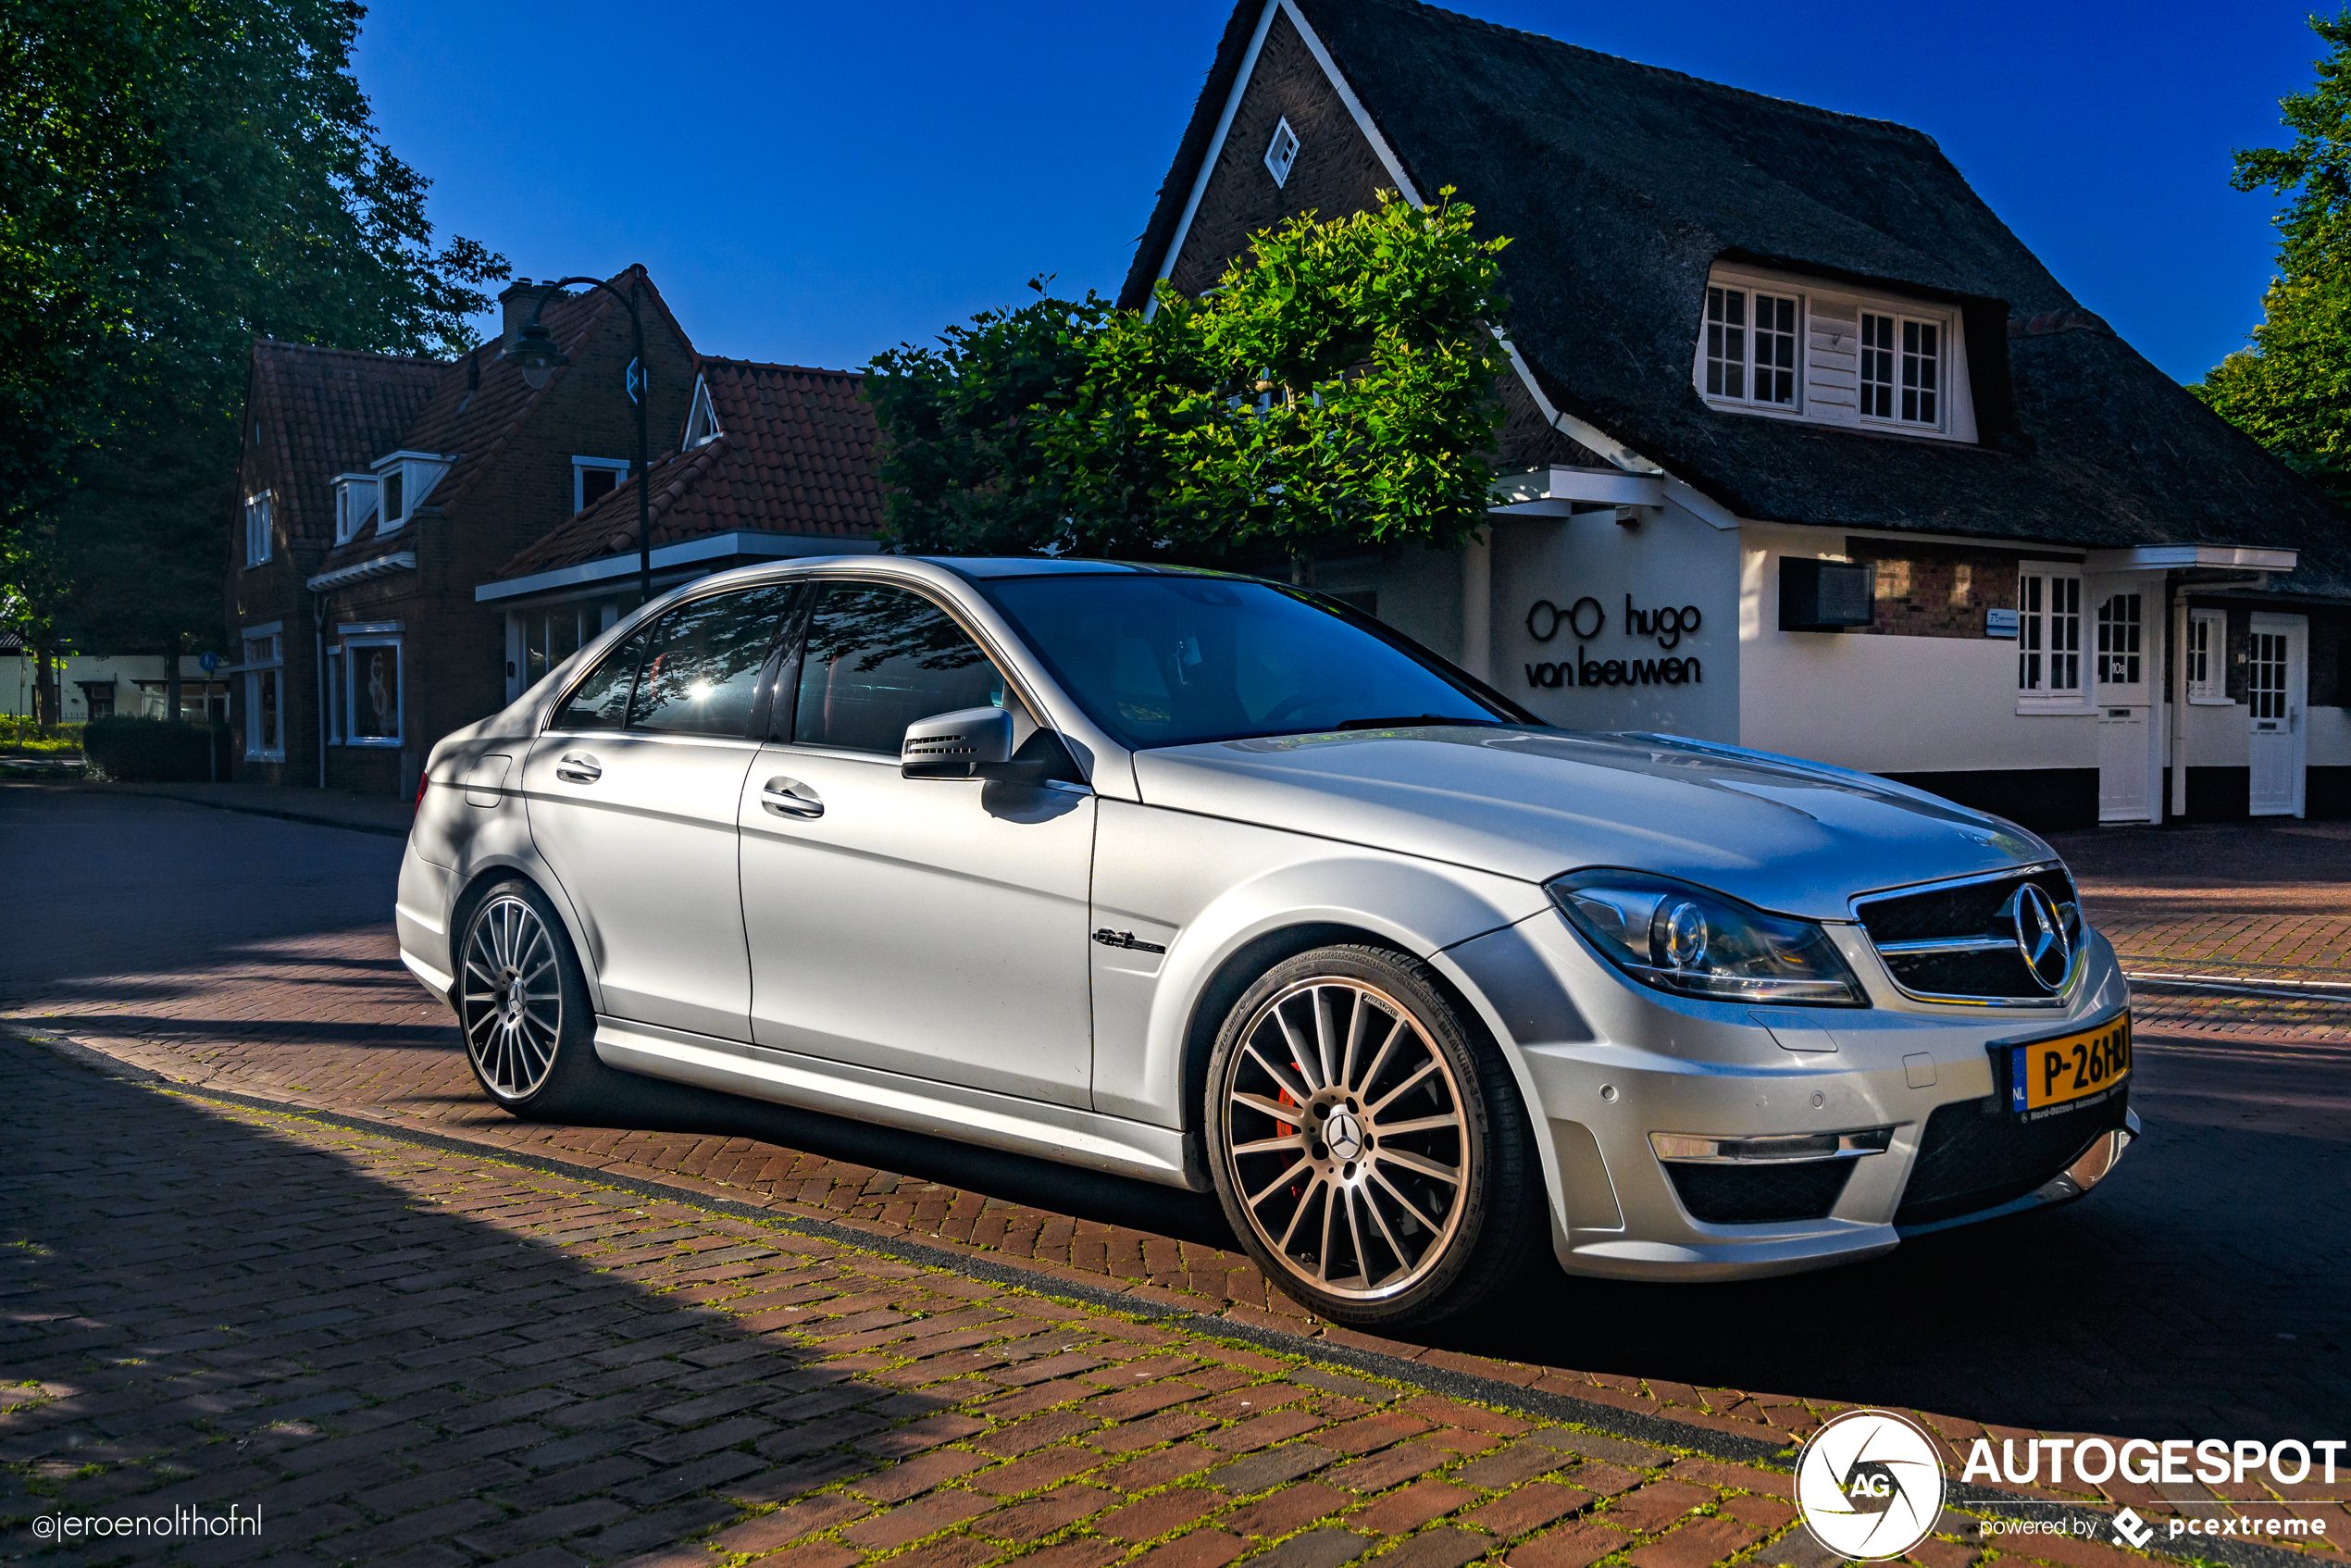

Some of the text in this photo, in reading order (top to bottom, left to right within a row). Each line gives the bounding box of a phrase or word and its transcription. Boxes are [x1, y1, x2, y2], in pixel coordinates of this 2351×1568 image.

[1625, 593, 1701, 649] hugo
[1525, 645, 1701, 687] van leeuwen
[1437, 1020, 1475, 1086] BRAVURIS
[2012, 1087, 2025, 1101] NL
